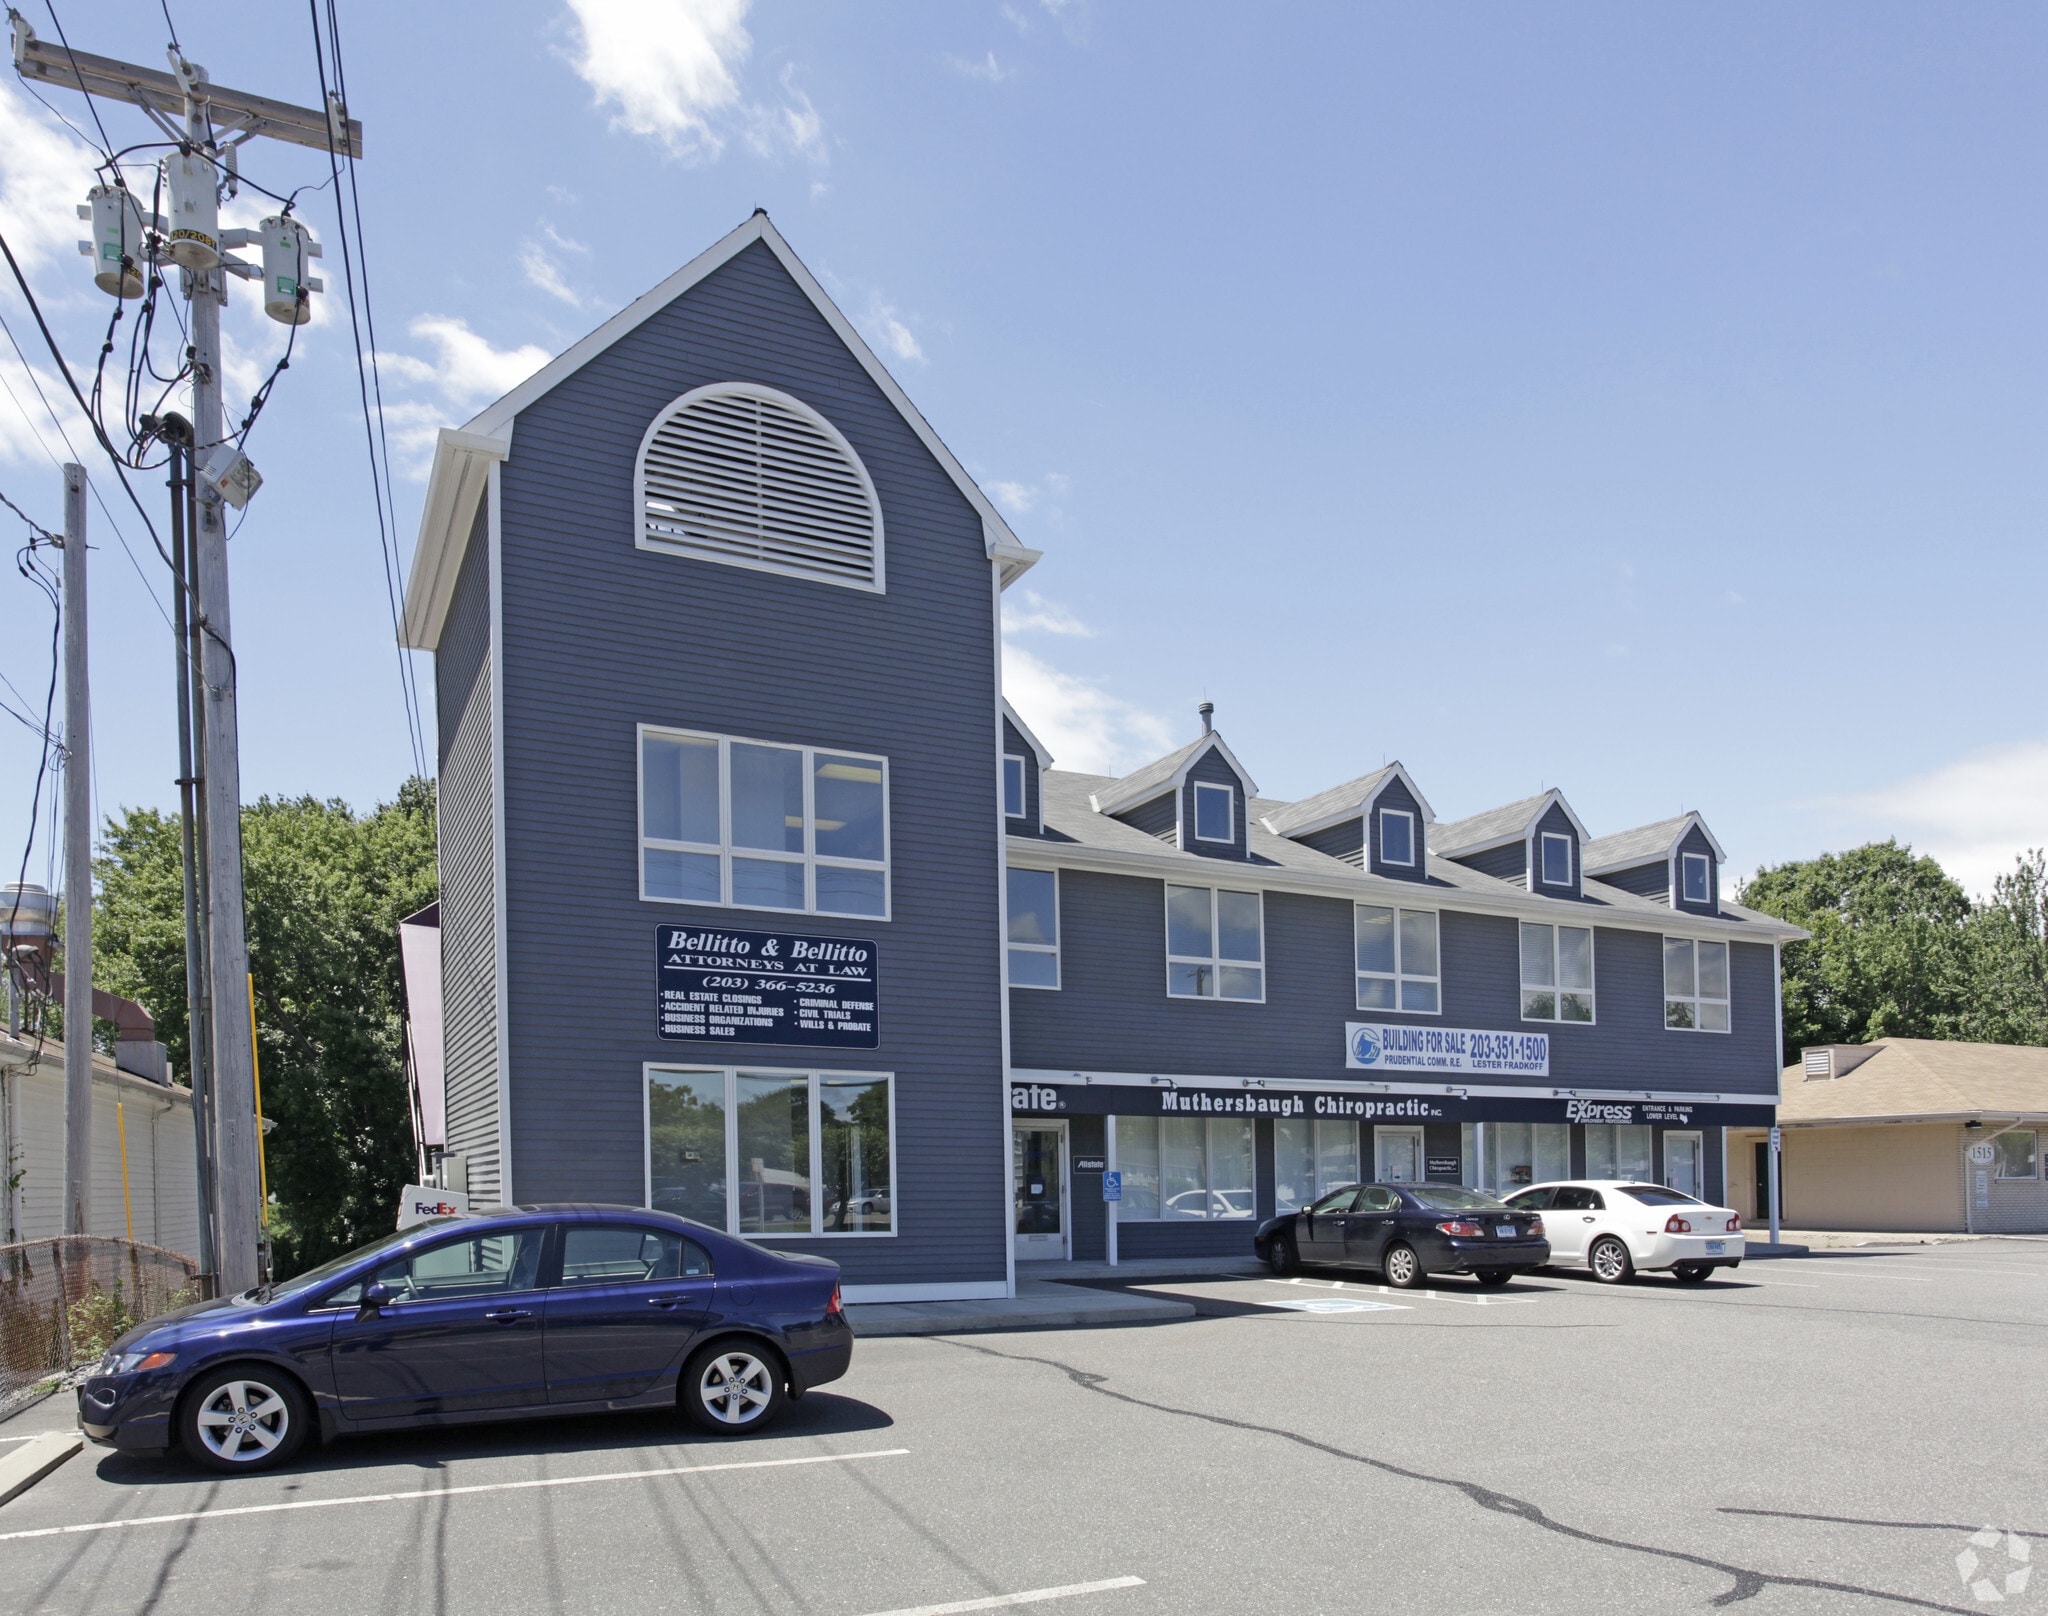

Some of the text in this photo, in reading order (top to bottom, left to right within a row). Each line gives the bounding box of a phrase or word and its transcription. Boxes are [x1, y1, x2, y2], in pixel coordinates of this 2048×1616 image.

[667, 930, 868, 962] Bellitto & Bellitto
[668, 953, 868, 976] ATTORNEYS AT LAW
[702, 976, 836, 994] (203) 366-5236
[664, 990, 762, 1004] REAL ESTATE CLOSINGS
[664, 1002, 784, 1017] ACCIDENT RELATED INJURIES
[799, 998, 874, 1011] CRIMINAL DEFENSE
[664, 1013, 773, 1027] BUSINESS ORGANIZATIONS
[799, 1008, 851, 1020] CIVIL TRIALS
[664, 1024, 735, 1036] BUSINESS SALES
[800, 1020, 872, 1032] WILLS & PROBATE
[1383, 1028, 1546, 1061] BUILDING FOR SALE 203-351-1500
[1384, 1055, 1426, 1066] PRUDENTIAL
[1427, 1056, 1449, 1067] COMM.
[1472, 1059, 1544, 1071] LESTER FRADKOFF
[1011, 1084, 1057, 1111] ate
[1162, 1091, 1304, 1116] Muthersbaugh
[1314, 1096, 1429, 1118] Chiropractic
[1642, 1104, 1666, 1112] ENTRANCE
[1646, 1112, 1663, 1120] LOWER
[1972, 1146, 1992, 1159] 1515
[1078, 1160, 1104, 1169] Allstate
[415, 1202, 457, 1215] FedEx
